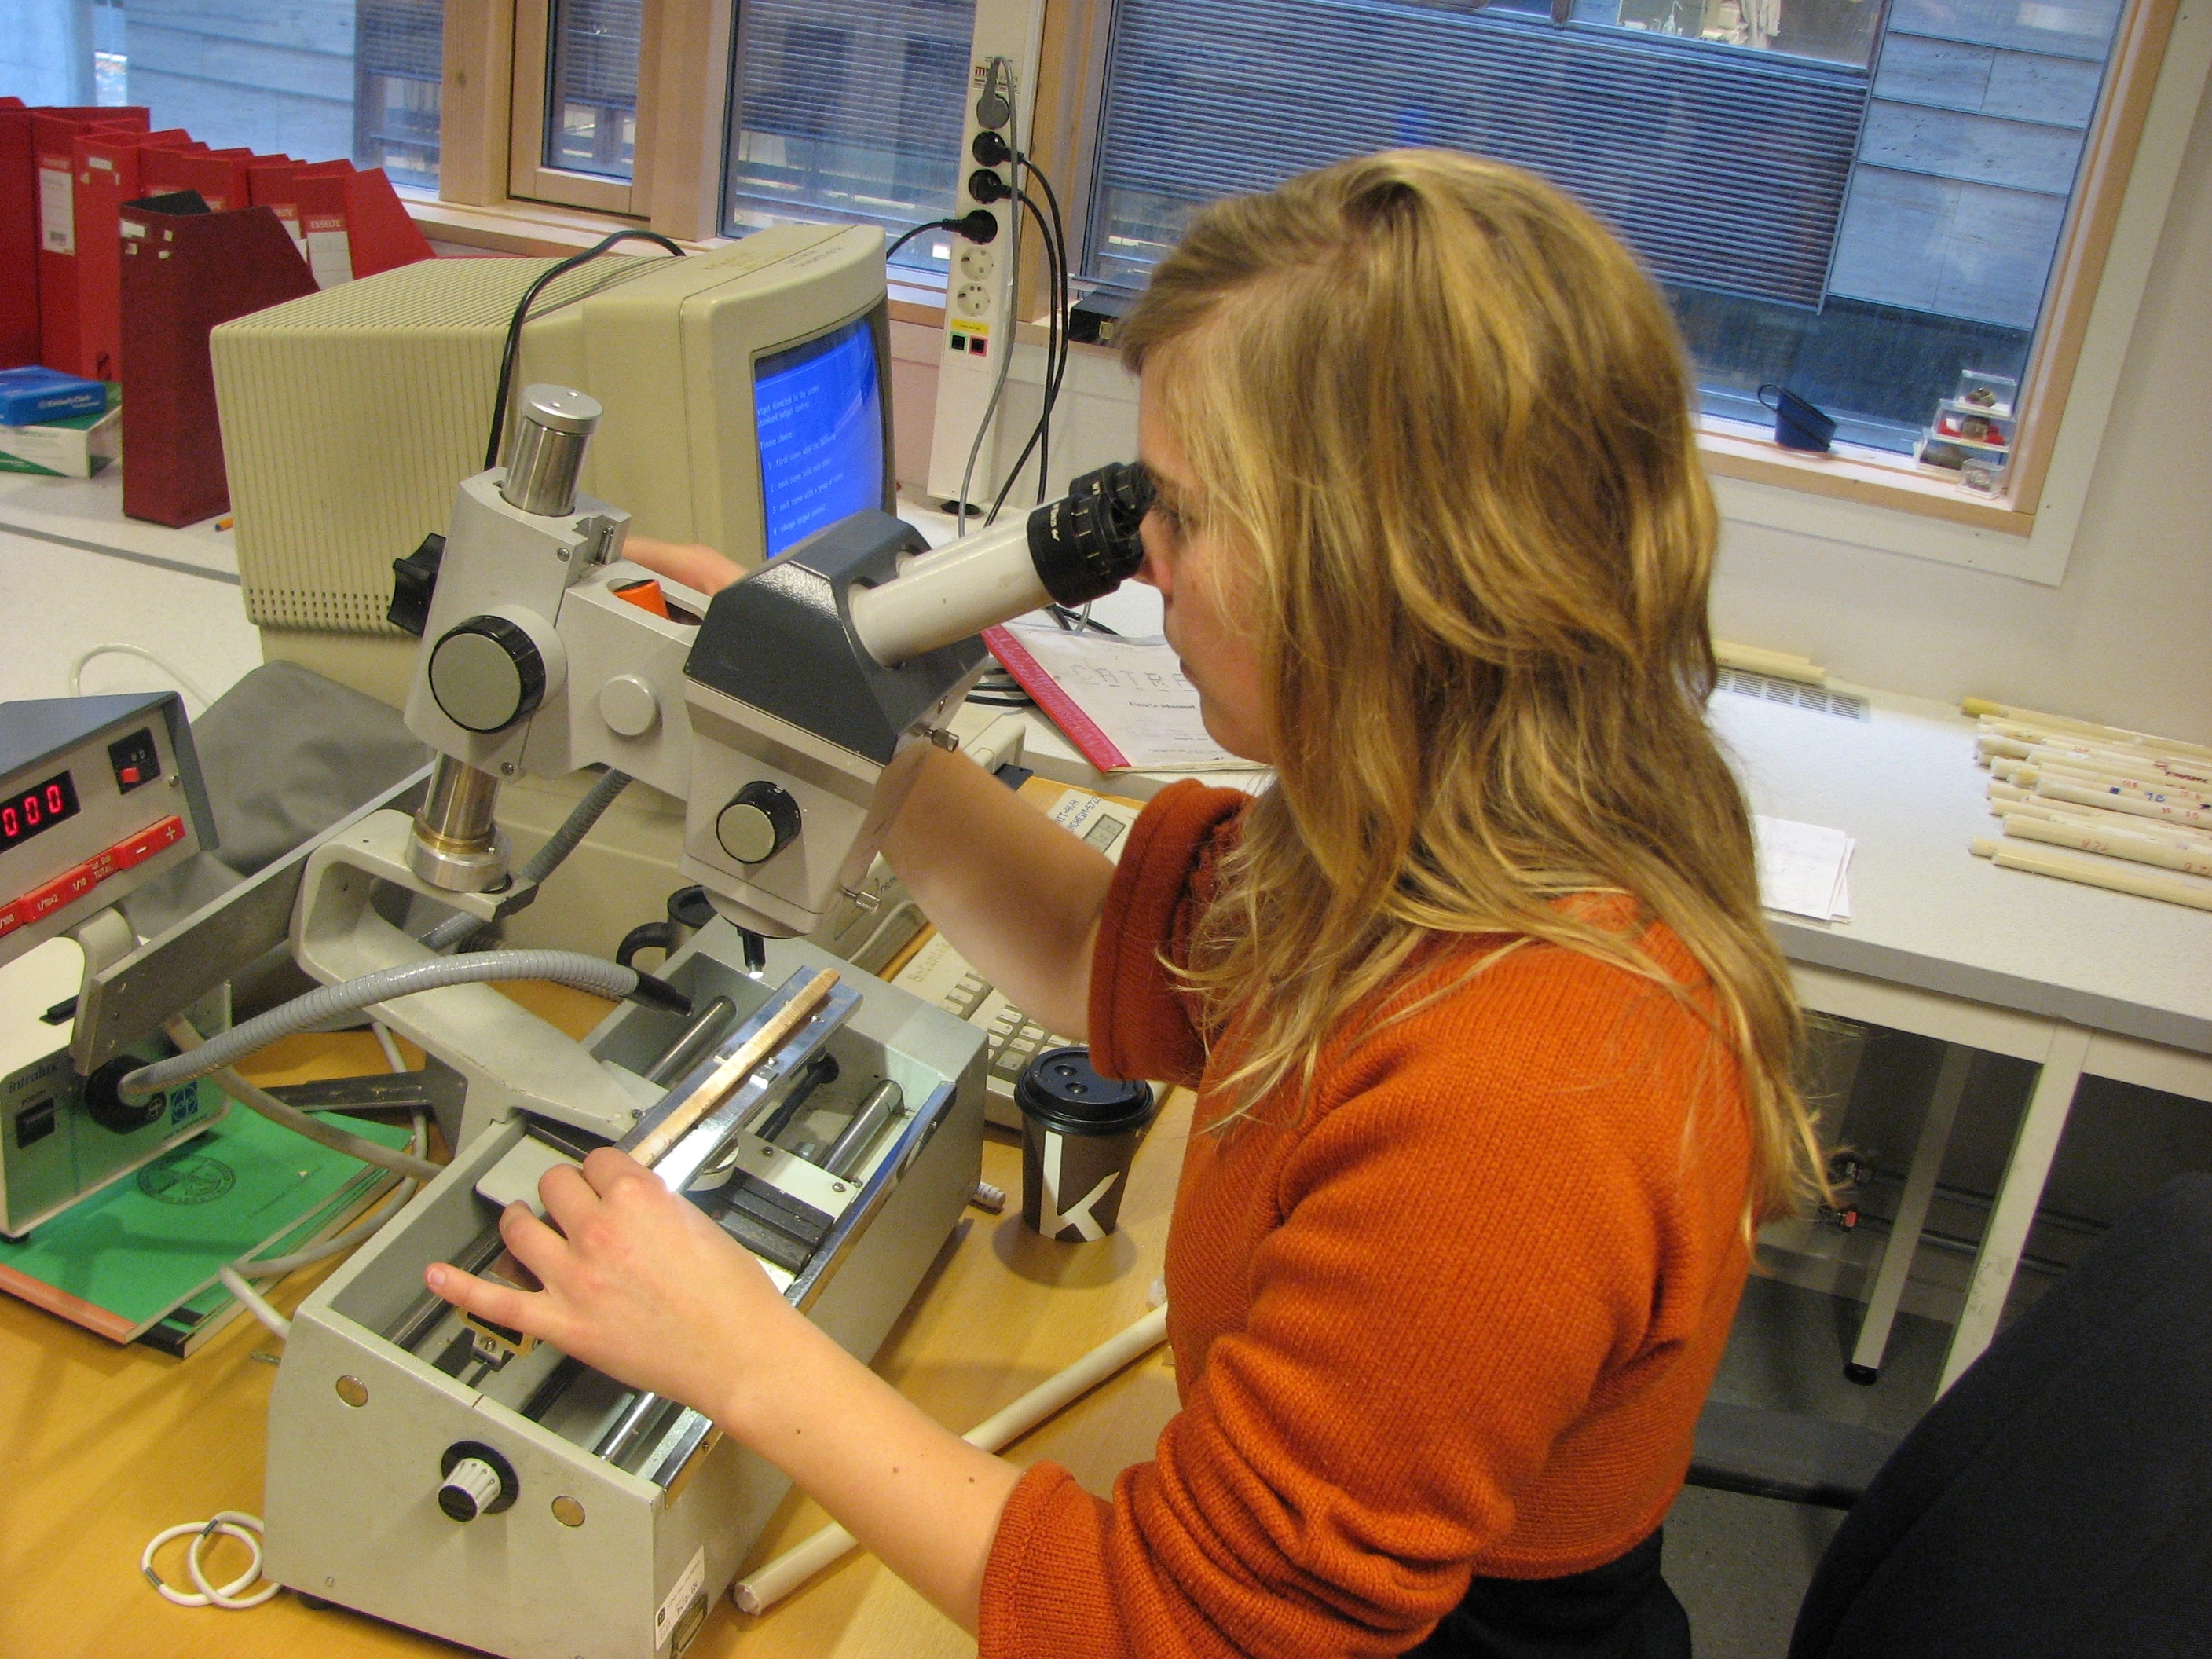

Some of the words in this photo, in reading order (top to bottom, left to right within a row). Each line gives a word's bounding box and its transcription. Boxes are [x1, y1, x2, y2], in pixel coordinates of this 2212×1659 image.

[311, 219, 342, 229] ESSELTE
[93, 865, 114, 879] TOTAL
[72, 877, 87, 891] 1/10
[0, 913, 15, 928] /100
